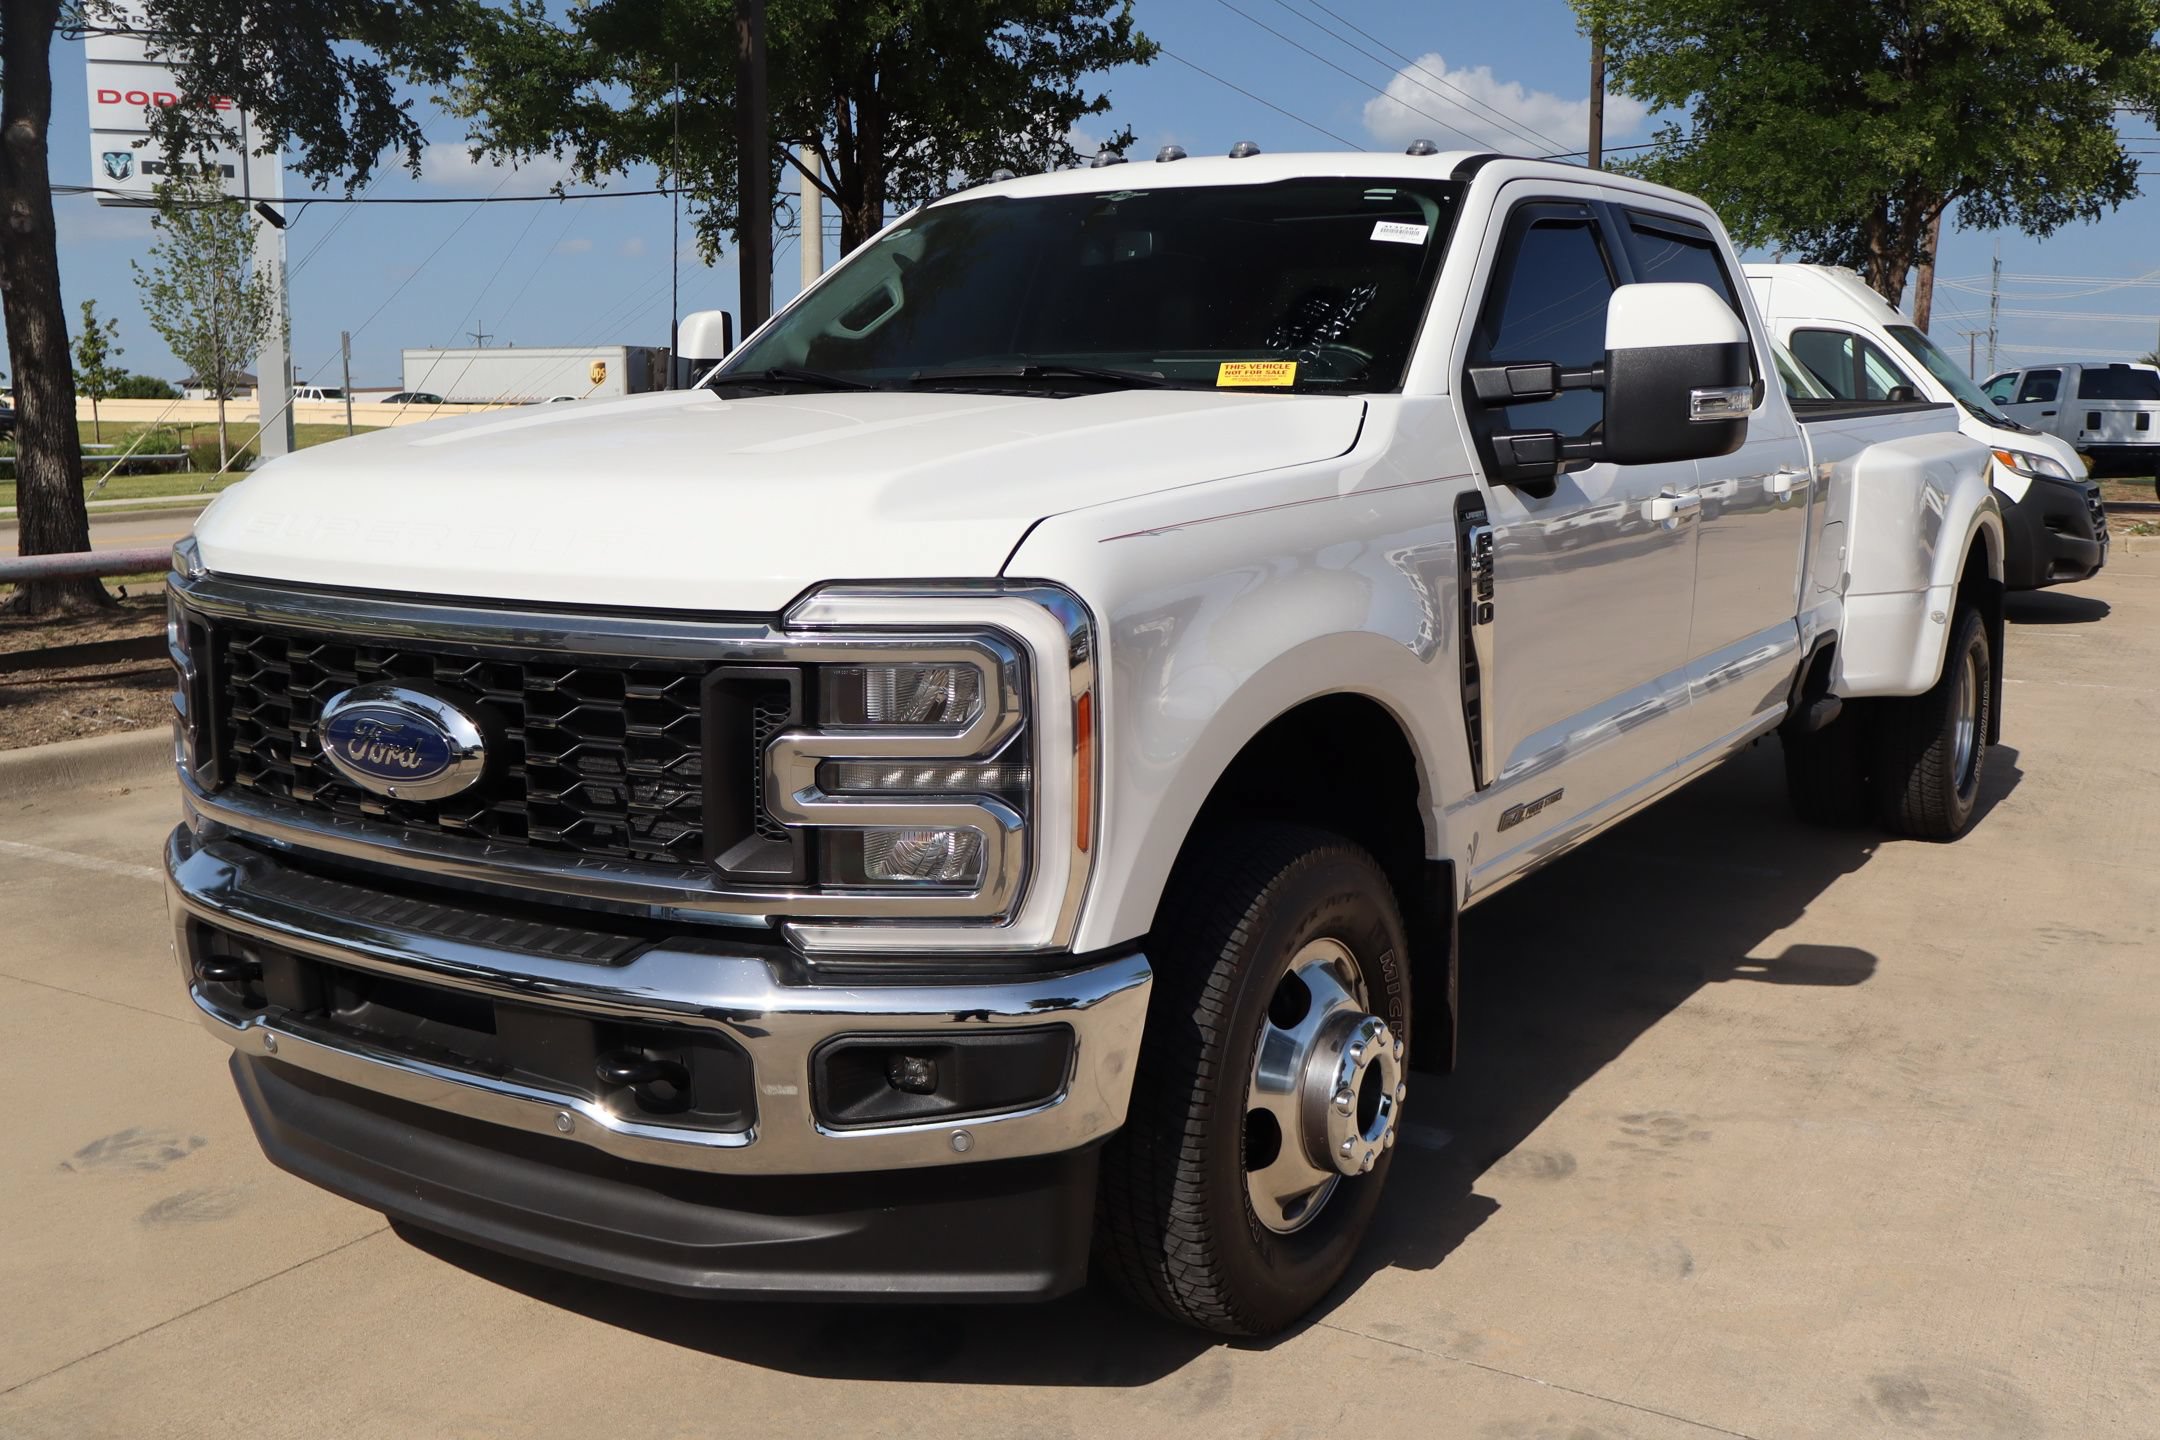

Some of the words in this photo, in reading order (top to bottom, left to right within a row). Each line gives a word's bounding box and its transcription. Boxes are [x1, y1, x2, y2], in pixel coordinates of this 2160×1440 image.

[97, 89, 232, 110] DODE
[347, 717, 424, 769] Ford
[1380, 949, 1403, 1041] MICH
